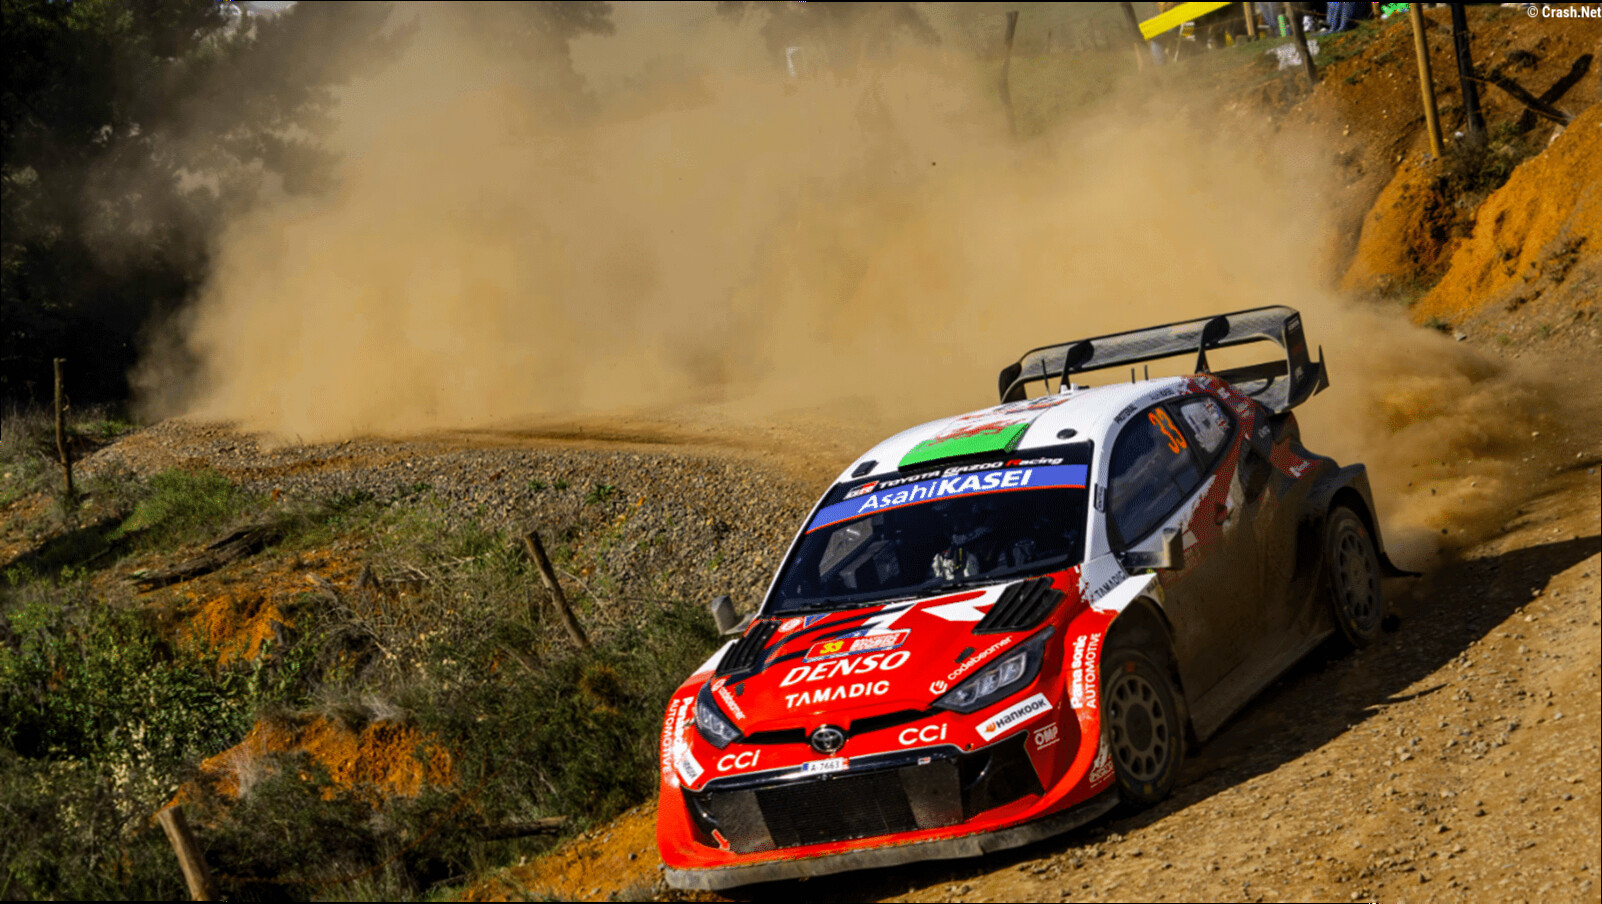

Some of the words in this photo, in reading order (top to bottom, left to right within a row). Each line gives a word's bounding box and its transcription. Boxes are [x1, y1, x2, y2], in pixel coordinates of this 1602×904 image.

[1147, 408, 1187, 454] 33
[879, 470, 940, 489] TOYOTA
[1005, 457, 1064, 468] Racing
[819, 640, 845, 655] 33
[947, 635, 1013, 680] codebeamer
[779, 650, 911, 687] DENSO
[1070, 635, 1088, 709] Panasonic
[1084, 632, 1101, 709] AUTOMOTIVE
[785, 680, 890, 709] TAMADIC
[662, 699, 681, 774] AUTOMOTIVE
[1034, 725, 1058, 746] OMP
